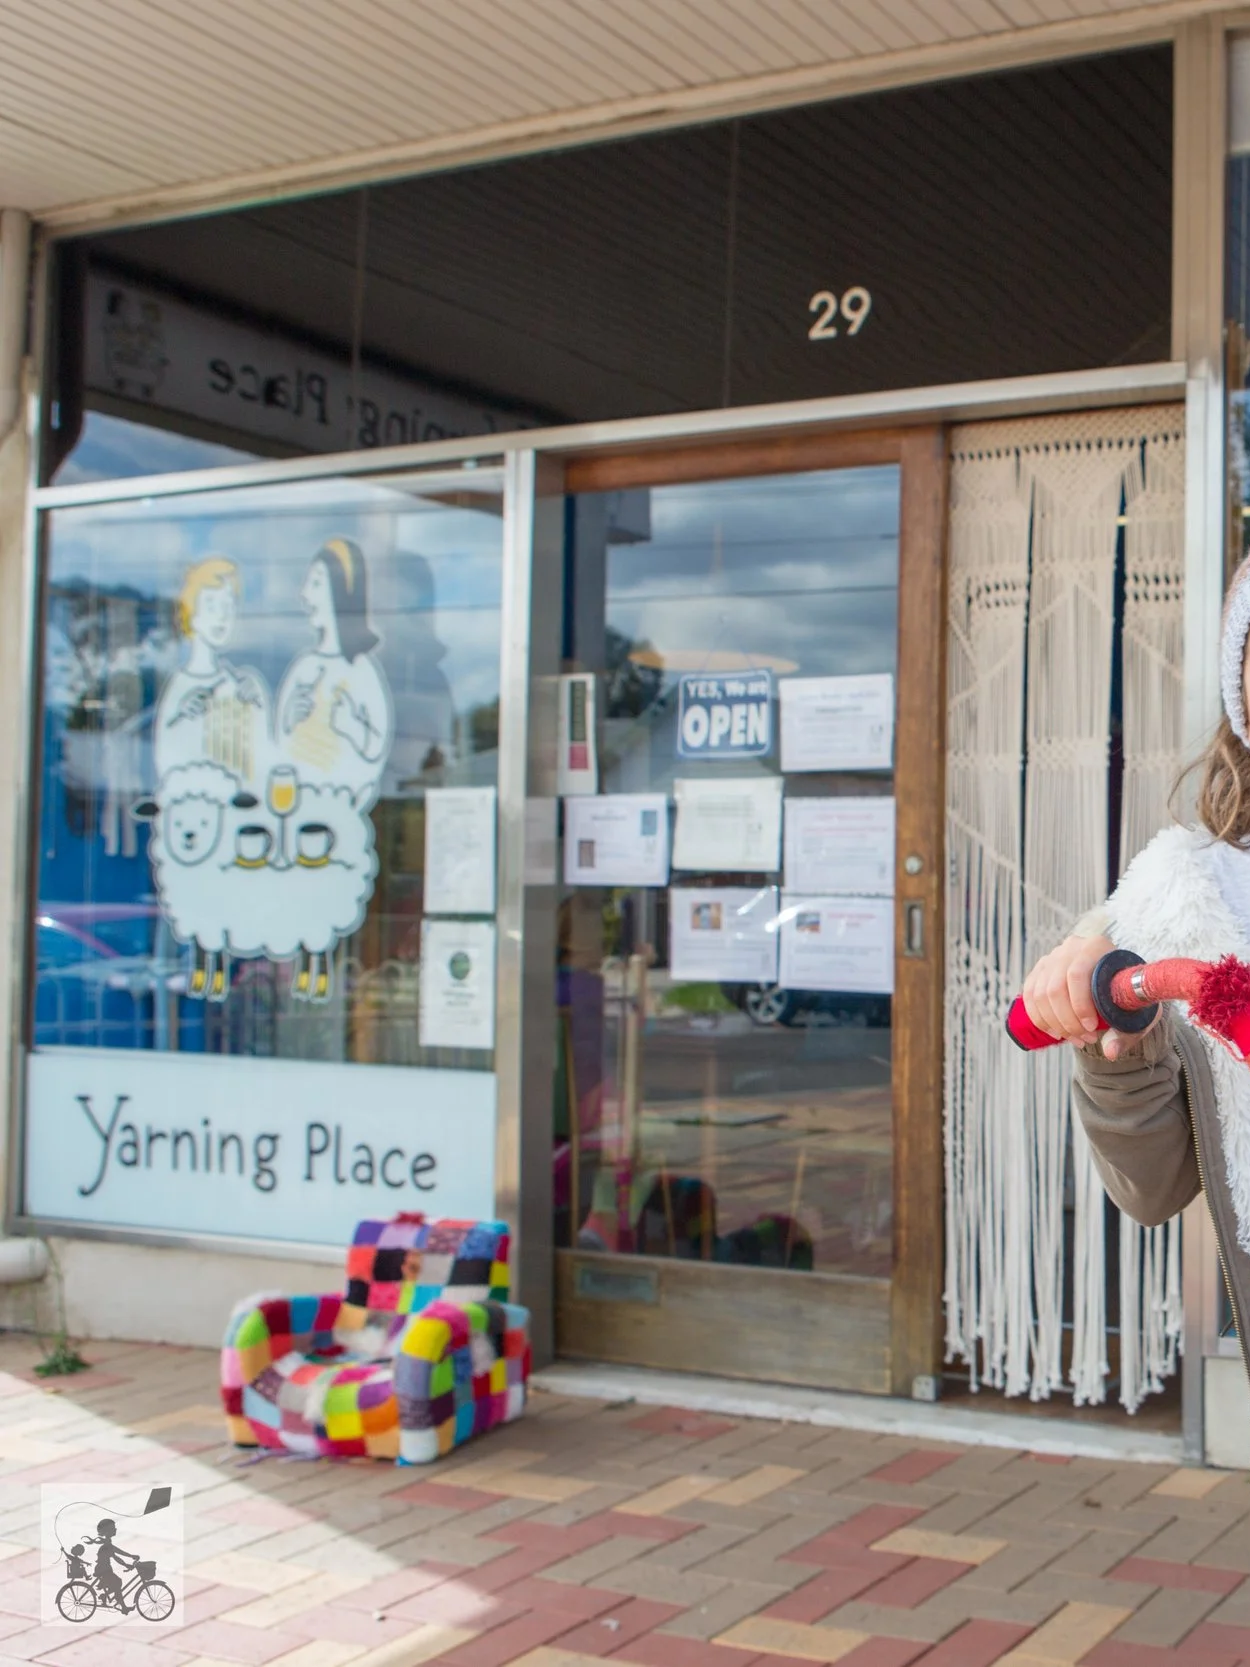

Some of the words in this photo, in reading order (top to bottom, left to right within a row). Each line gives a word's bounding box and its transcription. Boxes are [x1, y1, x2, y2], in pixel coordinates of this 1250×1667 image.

[808, 286, 872, 341] 29
[687, 680, 722, 700] YES,
[683, 703, 768, 748] OPEN
[76, 1094, 281, 1197] Yarning
[304, 1121, 438, 1191] Place
